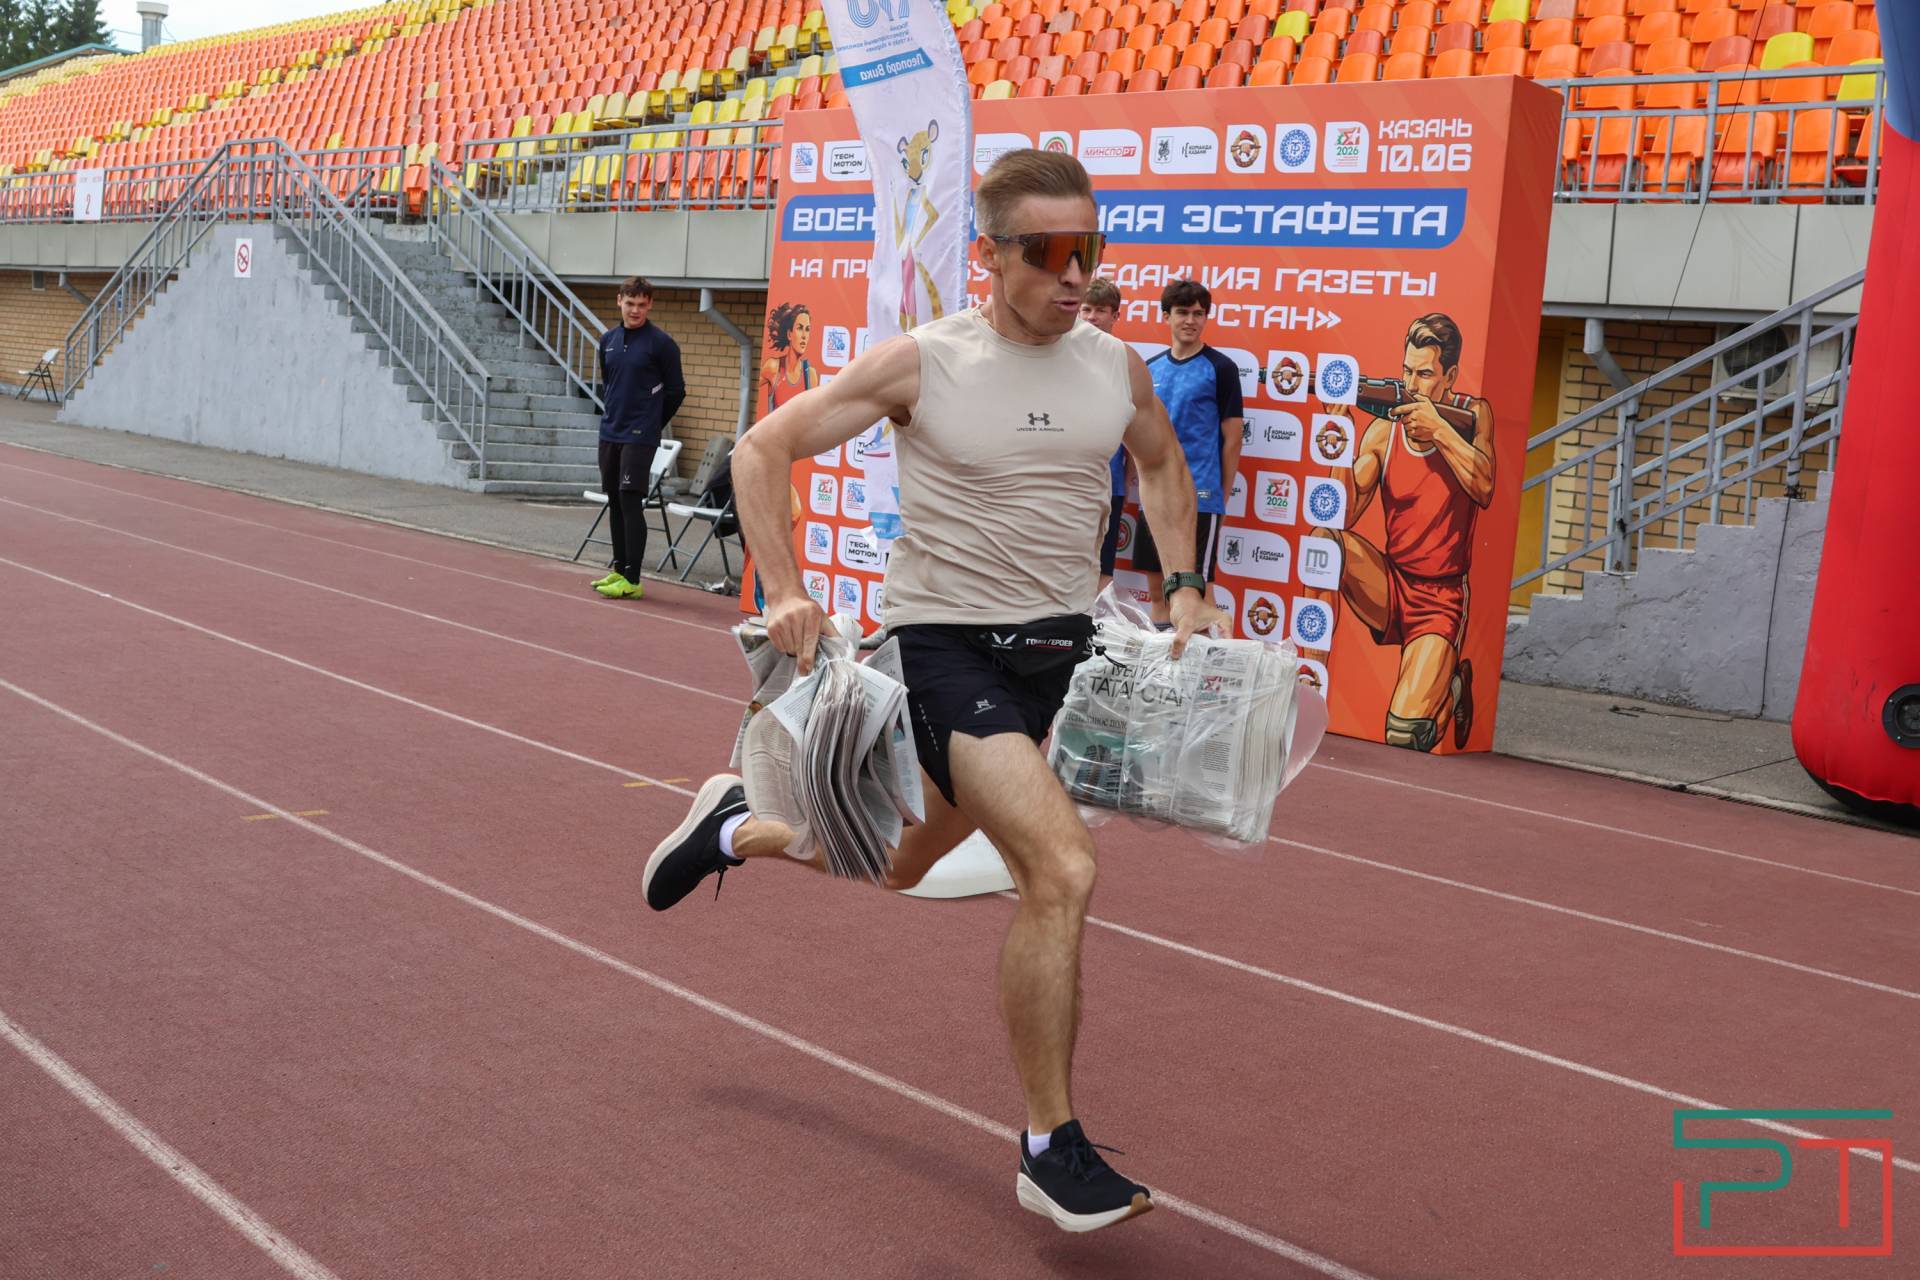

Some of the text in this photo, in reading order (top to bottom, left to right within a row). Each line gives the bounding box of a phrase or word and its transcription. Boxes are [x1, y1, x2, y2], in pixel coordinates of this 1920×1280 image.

[1378, 118, 1473, 139] КАЗАНЬ
[1336, 146, 1359, 156] 2026
[1377, 143, 1472, 172] 10.06
[833, 160, 862, 168] MOTION
[1182, 202, 1447, 235] ЭСТАФЕТА
[789, 258, 824, 279] НА
[1094, 263, 1260, 290] ЕДАКЦИЯ
[1275, 268, 1436, 296] ГАЗЕТЫ
[1266, 496, 1288, 507] 2026
[849, 540, 870, 550] TECH
[848, 548, 878, 559] MOTION
